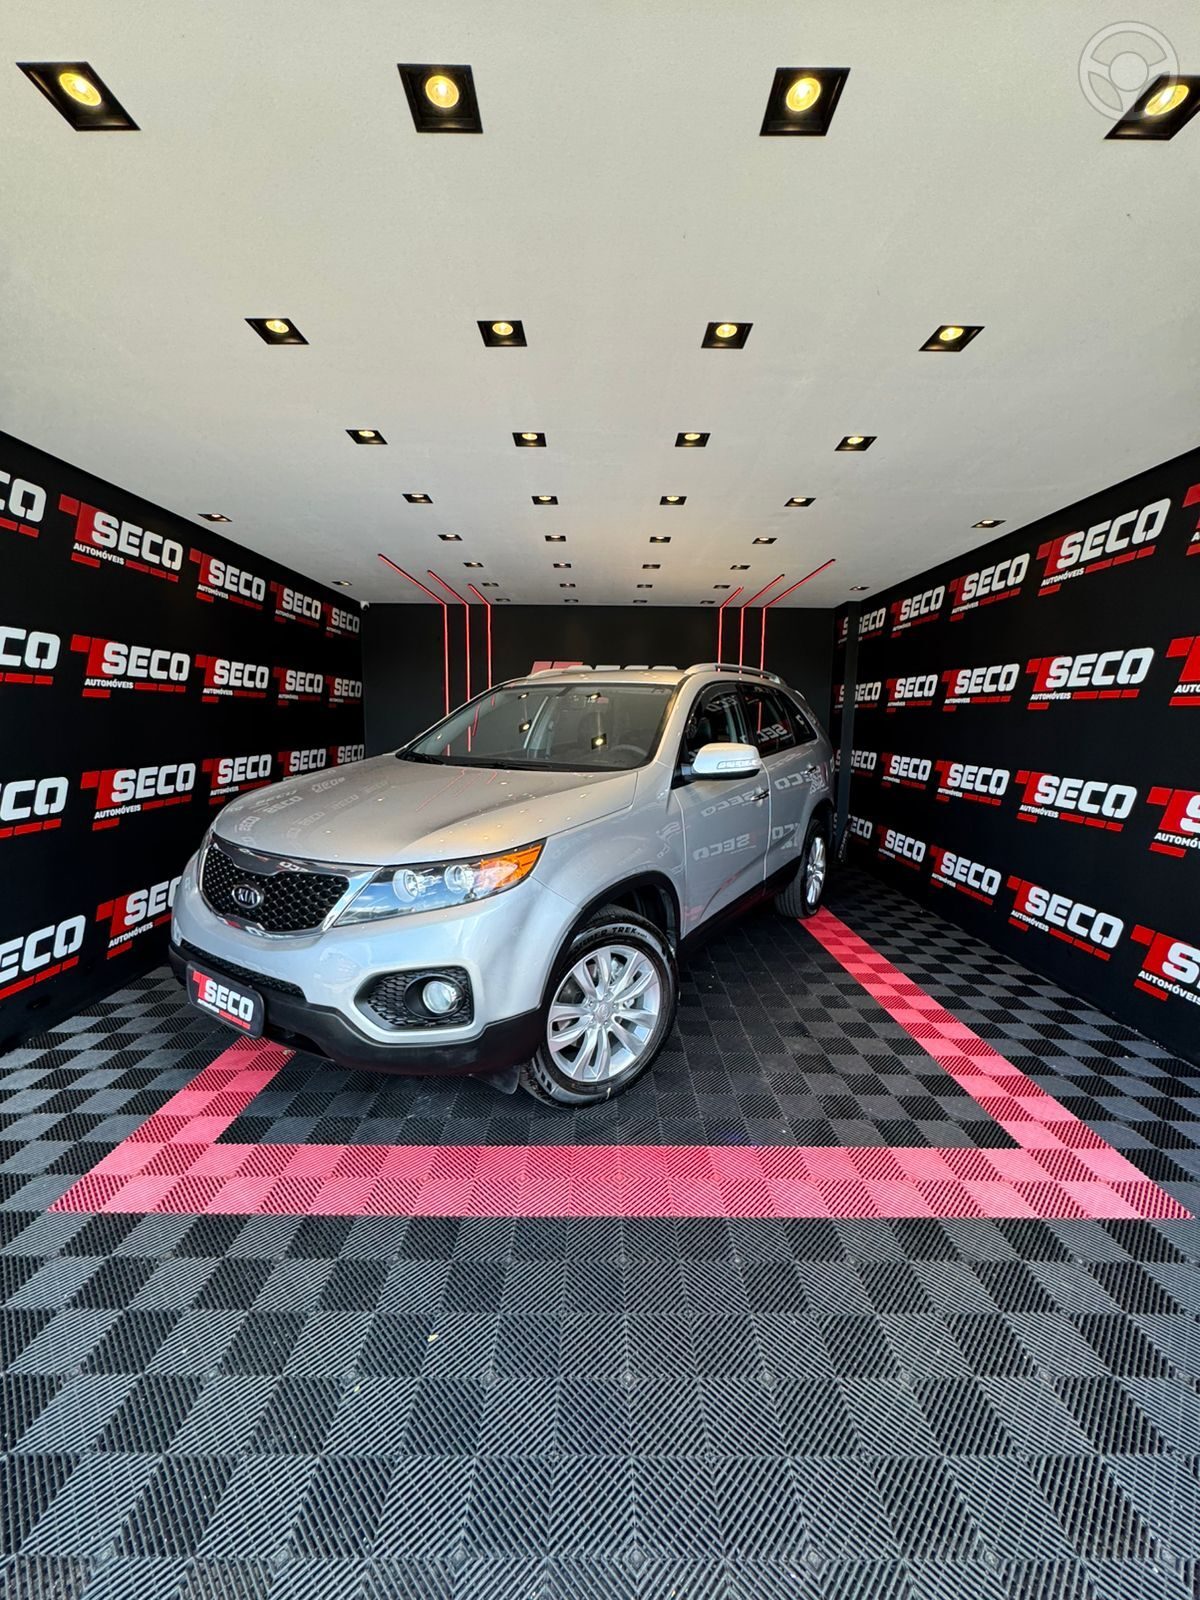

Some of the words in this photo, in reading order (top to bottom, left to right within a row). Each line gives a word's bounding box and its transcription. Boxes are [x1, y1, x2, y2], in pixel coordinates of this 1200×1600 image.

[73, 542, 125, 565] AUTOMÓVEIS
[84, 678, 134, 689] AUTOMÓVEIS
[94, 804, 141, 820] AUTOMÓVEIS
[1154, 832, 1200, 850] AUTOMÓ
[238, 888, 256, 904] KIA
